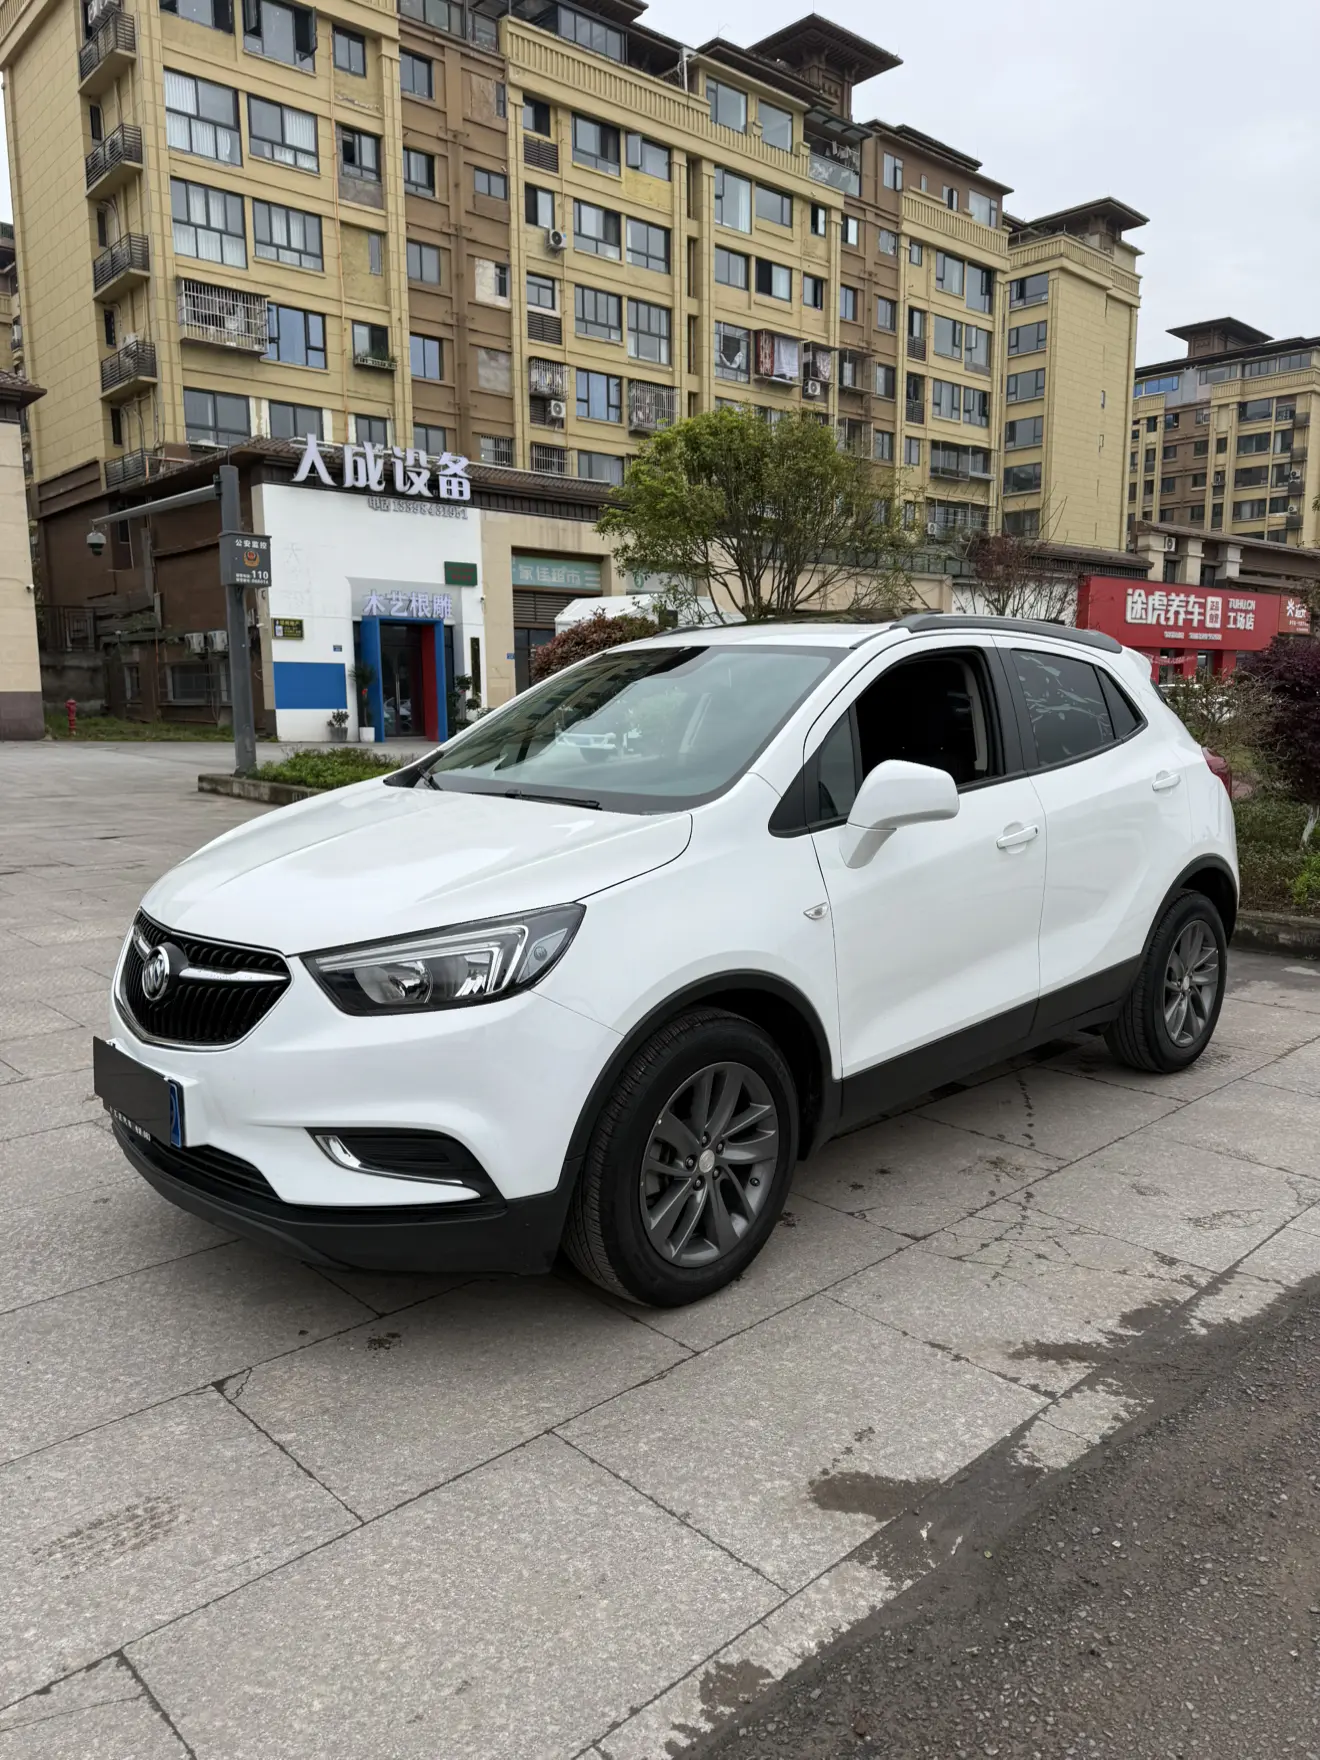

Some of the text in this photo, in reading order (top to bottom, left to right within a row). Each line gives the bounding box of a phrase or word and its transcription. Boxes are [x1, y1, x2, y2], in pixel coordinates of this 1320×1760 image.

[235, 539, 267, 550] 公安监控
[252, 570, 269, 580] 110
[363, 589, 453, 618] 木艺根雕
[1125, 588, 1205, 627] 途虎养车
[1227, 612, 1255, 631] 工场店
